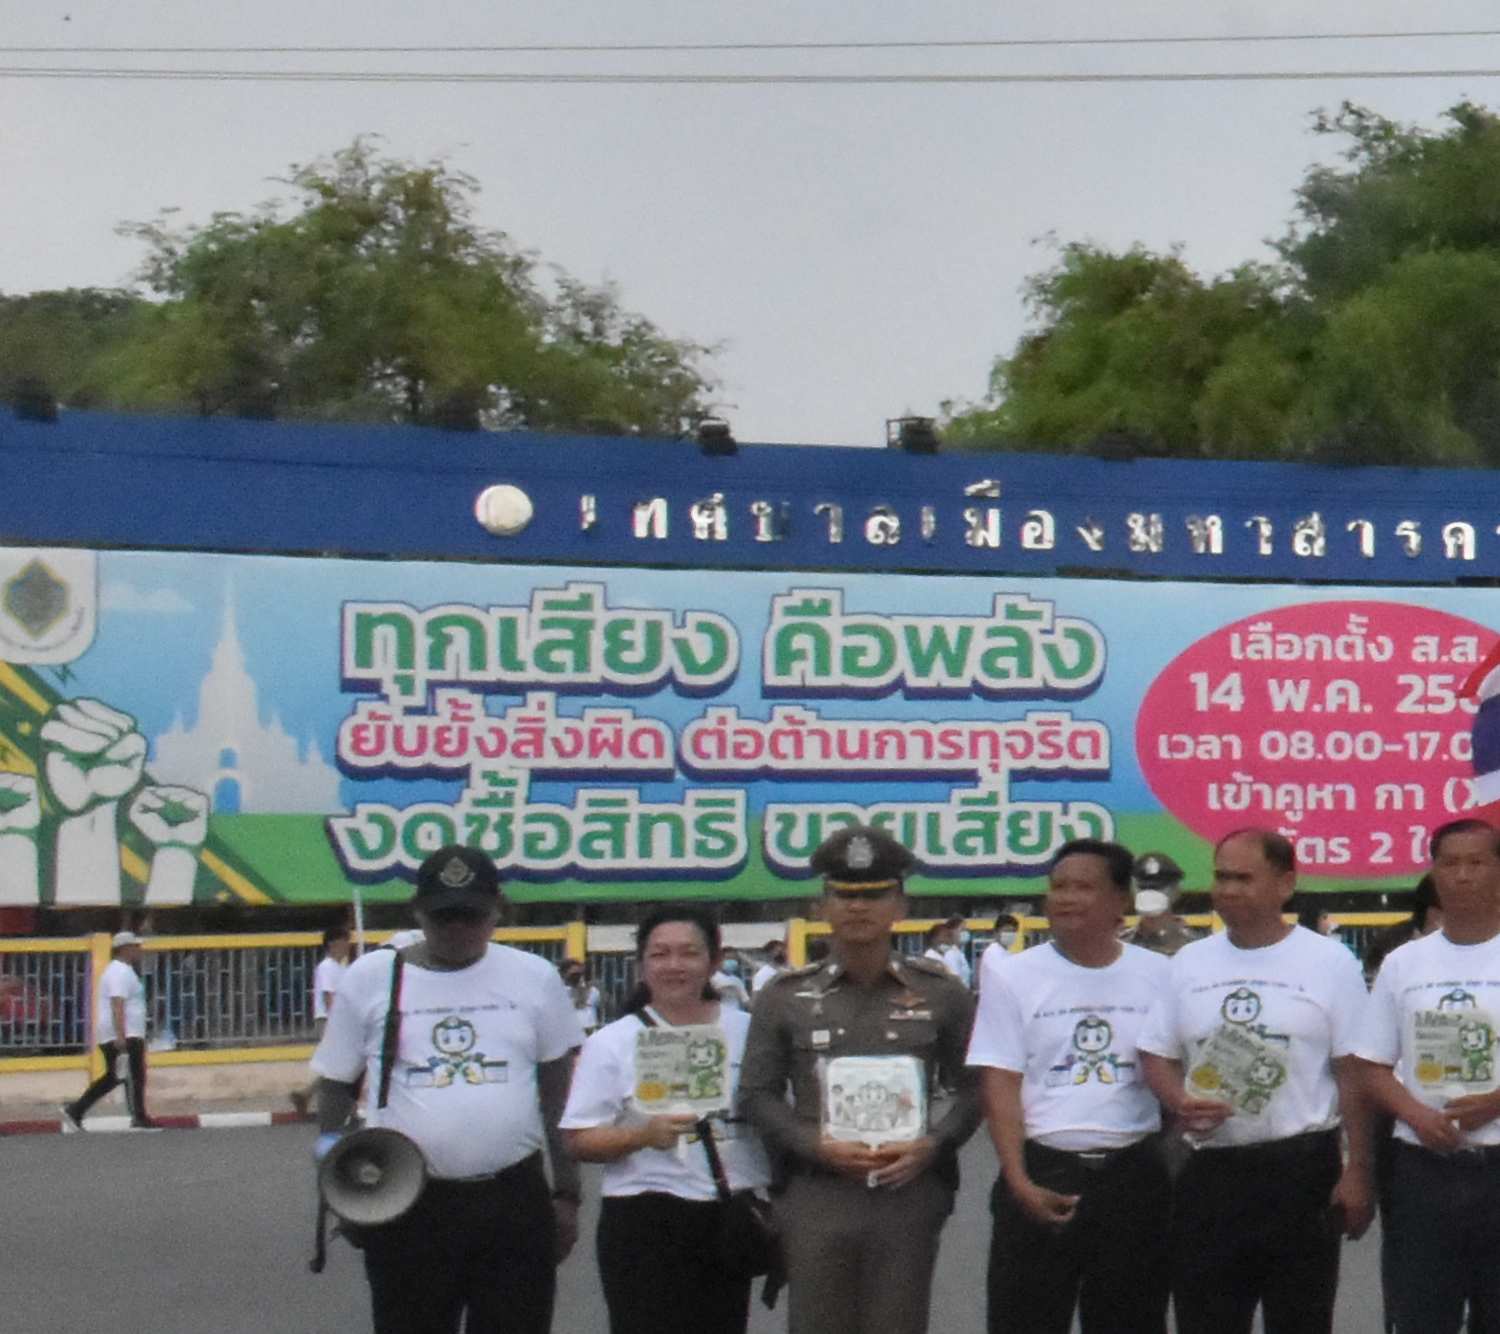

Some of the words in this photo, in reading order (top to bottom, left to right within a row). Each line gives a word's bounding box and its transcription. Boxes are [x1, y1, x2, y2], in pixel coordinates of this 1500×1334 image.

[352, 591, 730, 698] ทุกเสียง
[773, 597, 1096, 681] คือพลัง
[1230, 613, 1395, 663] เลือกตั้ง
[1411, 634, 1486, 663] ส.ส.
[1190, 672, 1245, 712] 14
[1267, 678, 1374, 714] พ.ค.
[1395, 674, 1481, 714] 25
[350, 697, 666, 760] ยับยั้งสิ่งผิด
[692, 715, 1102, 774] ต่อต้านการทุจริต
[1158, 733, 1242, 760] เวลา
[1259, 731, 1474, 761] 08.00-17.0
[344, 769, 738, 861] งดซื้อสิทธิ
[1207, 772, 1356, 822] เข้าคูหา
[1374, 782, 1425, 810] กา
[1443, 778, 1480, 813] (X
[1276, 826, 1351, 864] ัตร
[1369, 831, 1393, 863] 2
